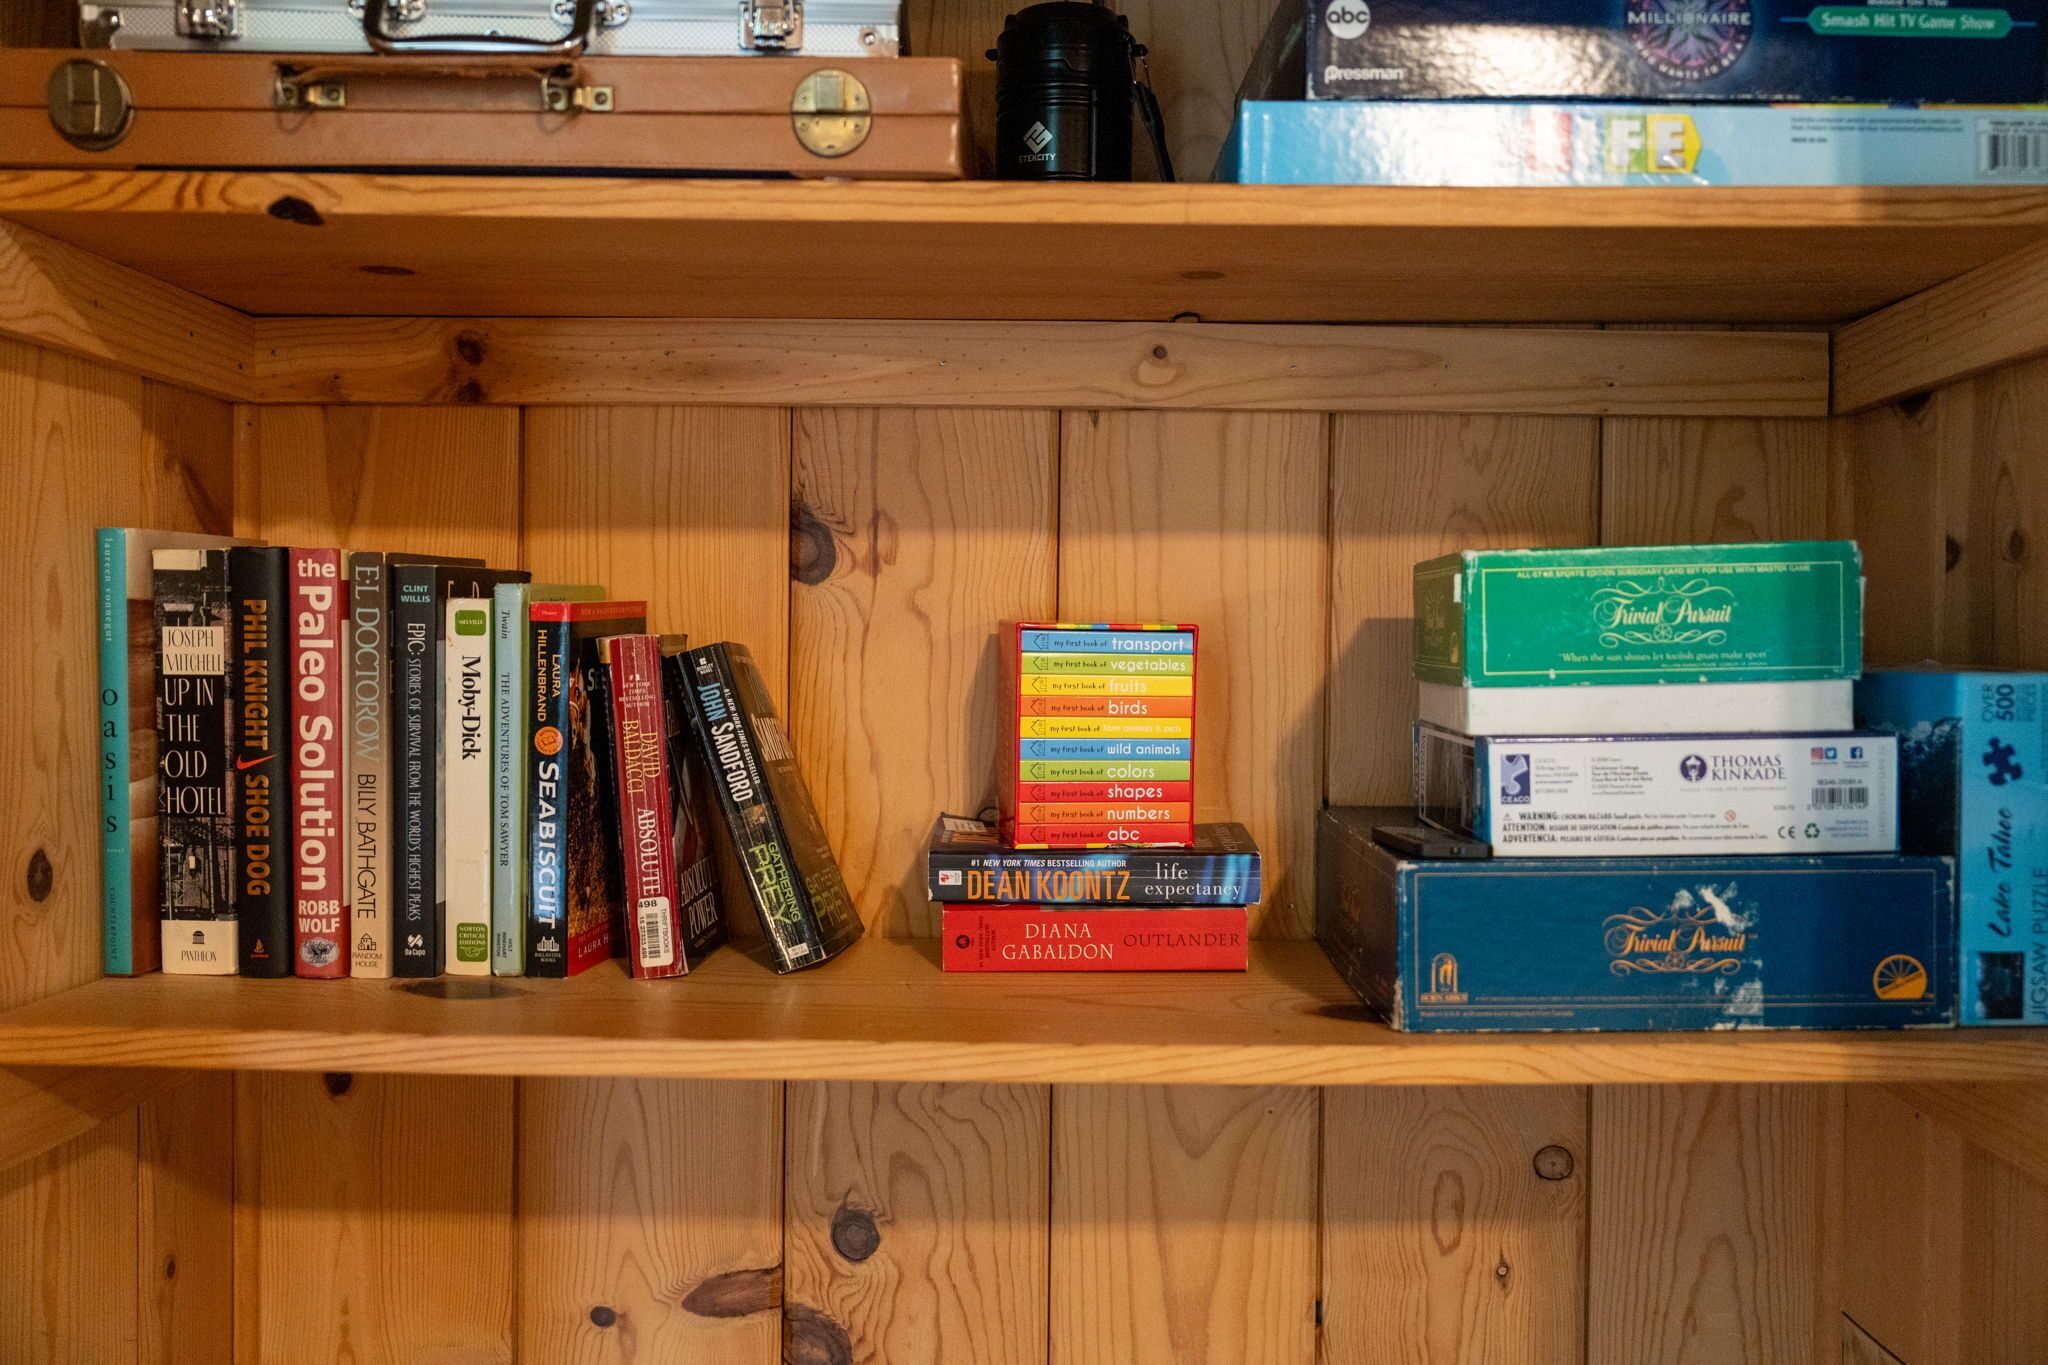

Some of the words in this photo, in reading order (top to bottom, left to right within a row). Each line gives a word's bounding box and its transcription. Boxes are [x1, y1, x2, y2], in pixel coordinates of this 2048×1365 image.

[1327, 8, 1368, 24] abc
[1627, 11, 1751, 25] MILLIONAIRE
[1822, 12, 1870, 28] Smash
[1874, 13, 1895, 28] Hit
[1900, 13, 1915, 28] TV
[1918, 15, 1956, 29] Game
[1960, 14, 1995, 30] Show
[297, 558, 336, 578] the
[1556, 569, 1585, 577] SPORTS
[1617, 568, 1661, 576] SUBSIDIARY
[1663, 567, 1684, 575] CARD
[1702, 566, 1716, 574] FOR
[1718, 566, 1733, 574] USE
[1736, 565, 1755, 573] WITH
[1789, 564, 1811, 572] GAME
[401, 595, 431, 603] WILLIS
[403, 585, 429, 593] CLINT
[104, 587, 112, 642] vonnegut
[501, 610, 511, 639] Twain
[1593, 596, 1665, 629] Trivial
[1663, 595, 1731, 626] Pursuit
[164, 629, 214, 648] JOSEPH
[243, 599, 268, 654] PHIL
[407, 622, 426, 655] EPIC:
[299, 586, 334, 702] Paleo
[1111, 637, 1184, 653] transport
[1590, 653, 1604, 661] the
[1624, 653, 1650, 661] shines
[1653, 652, 1664, 661] let
[1720, 651, 1742, 659] make
[1745, 651, 1766, 661] sport
[164, 653, 223, 673] MITCHELL
[408, 658, 421, 694] STORIES
[537, 629, 548, 722] HILLENBRAND
[552, 654, 562, 698] LAURA
[1111, 659, 1186, 673] vegetables
[164, 678, 190, 706] UP
[196, 678, 214, 706] IN
[355, 608, 380, 763] DOCTOROW
[500, 672, 510, 695] THE
[1109, 679, 1146, 693] fruits
[243, 660, 269, 751] KNIGHT
[408, 698, 421, 711] OF
[458, 656, 481, 760] Moby-Dick
[697, 682, 727, 722] JOHN
[1108, 700, 1148, 715] birds
[1995, 684, 2014, 721] 500
[165, 714, 201, 742] THE
[408, 714, 421, 759] SURVIVAL
[500, 698, 510, 773] ADVENTURES
[727, 699, 737, 712] NEW
[732, 713, 742, 729] YORK
[737, 729, 749, 748] TIMES
[744, 748, 761, 785] BESTSELLER
[622, 721, 645, 794] BALDACCI
[641, 732, 661, 779] DAVID
[711, 722, 754, 803] SANDFORD
[1107, 744, 1131, 755] wild
[1136, 744, 1181, 755] animals
[1710, 754, 1782, 768] THOMAS
[164, 750, 207, 778] OLD
[408, 761, 421, 788] FROM
[1107, 765, 1155, 778] colors
[1711, 767, 1788, 781] KINKADE
[357, 774, 376, 817] BILLY
[500, 775, 510, 791] OF
[1107, 784, 1163, 800] shapes
[166, 786, 225, 815] HOTEL
[245, 774, 270, 838] SHOE
[300, 716, 335, 891] Solution
[408, 791, 421, 807] THE
[500, 793, 510, 819] TOM
[1107, 807, 1170, 820] numbers
[1502, 823, 1546, 831] ATTENTION:
[1519, 812, 1559, 821] WARNING:
[500, 821, 510, 867] SAWYER
[538, 762, 560, 930] SEABISCUIT
[1107, 826, 1140, 841] abc
[1502, 835, 1558, 843] ADVERTENCIA:
[1987, 807, 2012, 873] Tahoe
[637, 808, 661, 896] ABSOLUTE
[971, 859, 980, 867] #1
[983, 859, 1000, 867] NEW
[1002, 859, 1021, 867] YORK
[1023, 859, 1046, 867] TIMES
[1047, 859, 1095, 867] BESTSELLING
[246, 844, 271, 896] DOG
[357, 822, 376, 920] BATHGATE
[408, 854, 421, 890] HIGHEST
[748, 844, 792, 924] PREY
[768, 841, 801, 922] GATHERING
[1155, 862, 1188, 881] life
[967, 870, 1030, 900] DEAN
[1037, 870, 1131, 900] KOONTZ
[1145, 882, 1242, 899] expectancy
[298, 900, 340, 916] ROBB
[408, 893, 421, 921] PEAKS
[1987, 881, 2012, 937] Lake
[2031, 867, 2048, 935] PUZZLE
[110, 887, 118, 960] COUNTERPOINT
[298, 918, 340, 934] WOLF
[687, 893, 719, 939] POWER
[661, 909, 671, 954] THRIFTBOOKS
[1025, 923, 1092, 939] DIANA
[1123, 932, 1241, 948] OUTLANDER
[1604, 924, 1678, 957] Trivial
[1676, 925, 1746, 955] Pursuit
[181, 950, 217, 962] PANTHEON
[352, 952, 383, 960] RANDOM
[413, 949, 426, 957] Capo
[578, 940, 602, 958] LAURA
[1002, 943, 1114, 960] GABALDON
[2031, 943, 2048, 1017] JIGSAW
